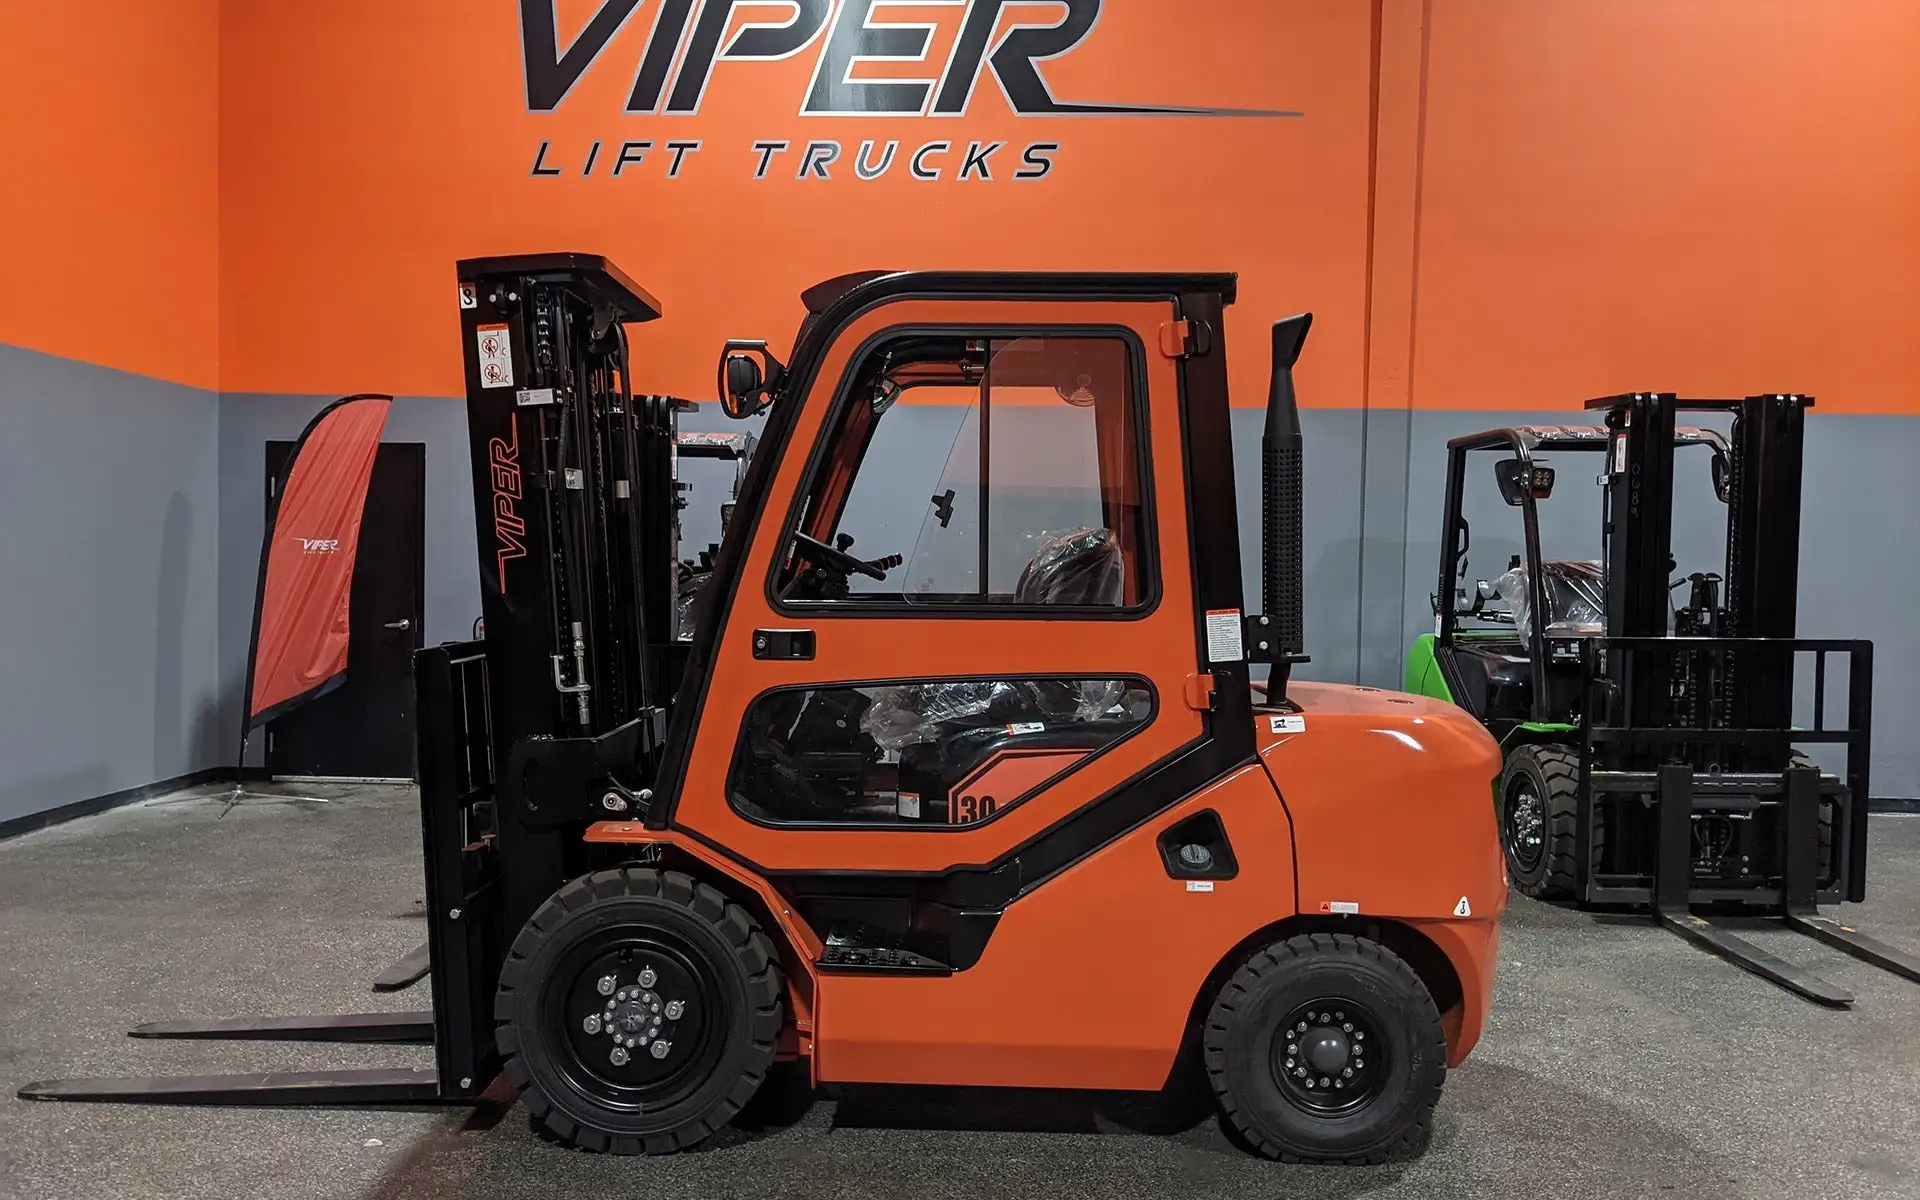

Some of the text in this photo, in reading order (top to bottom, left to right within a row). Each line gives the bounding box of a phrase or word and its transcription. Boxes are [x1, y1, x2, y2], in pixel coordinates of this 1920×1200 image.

[519, 0, 1104, 117] VIPER
[530, 139, 1061, 181] LIFT TRUCKS
[489, 437, 527, 557] VIPER
[303, 539, 341, 551] VIPER
